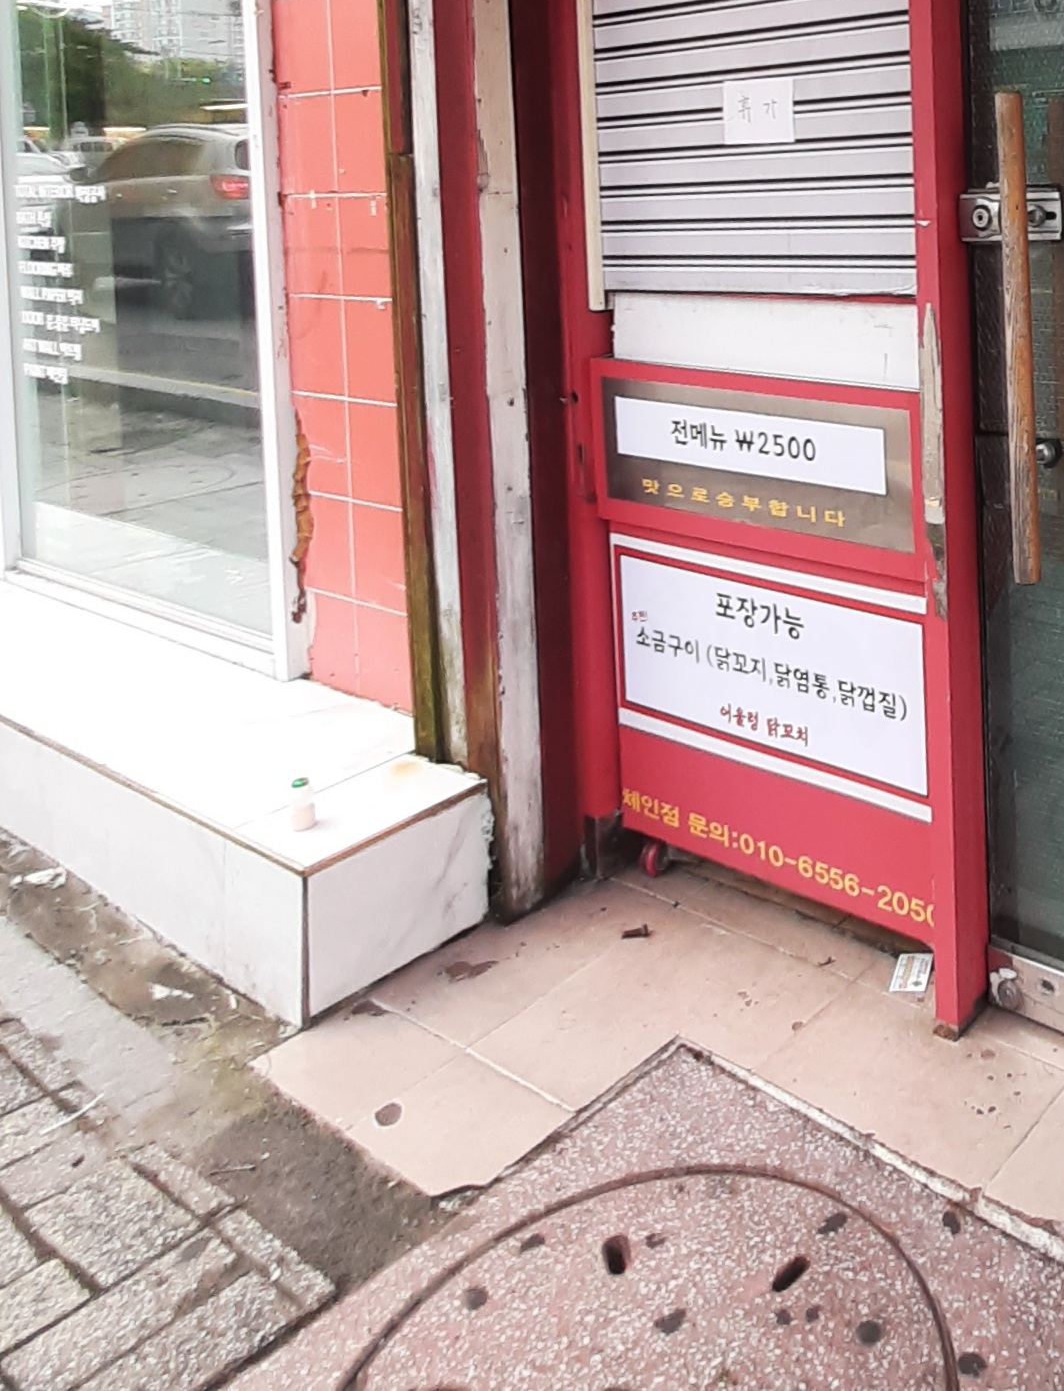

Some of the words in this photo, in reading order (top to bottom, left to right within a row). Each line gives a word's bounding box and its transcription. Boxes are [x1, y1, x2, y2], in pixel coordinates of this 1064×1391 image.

[671, 420, 727, 451] 전메뉴
[735, 429, 816, 461] ₩2500
[715, 592, 805, 640] 포장가능
[635, 626, 700, 663] 소금구이
[622, 788, 680, 828] 체인점
